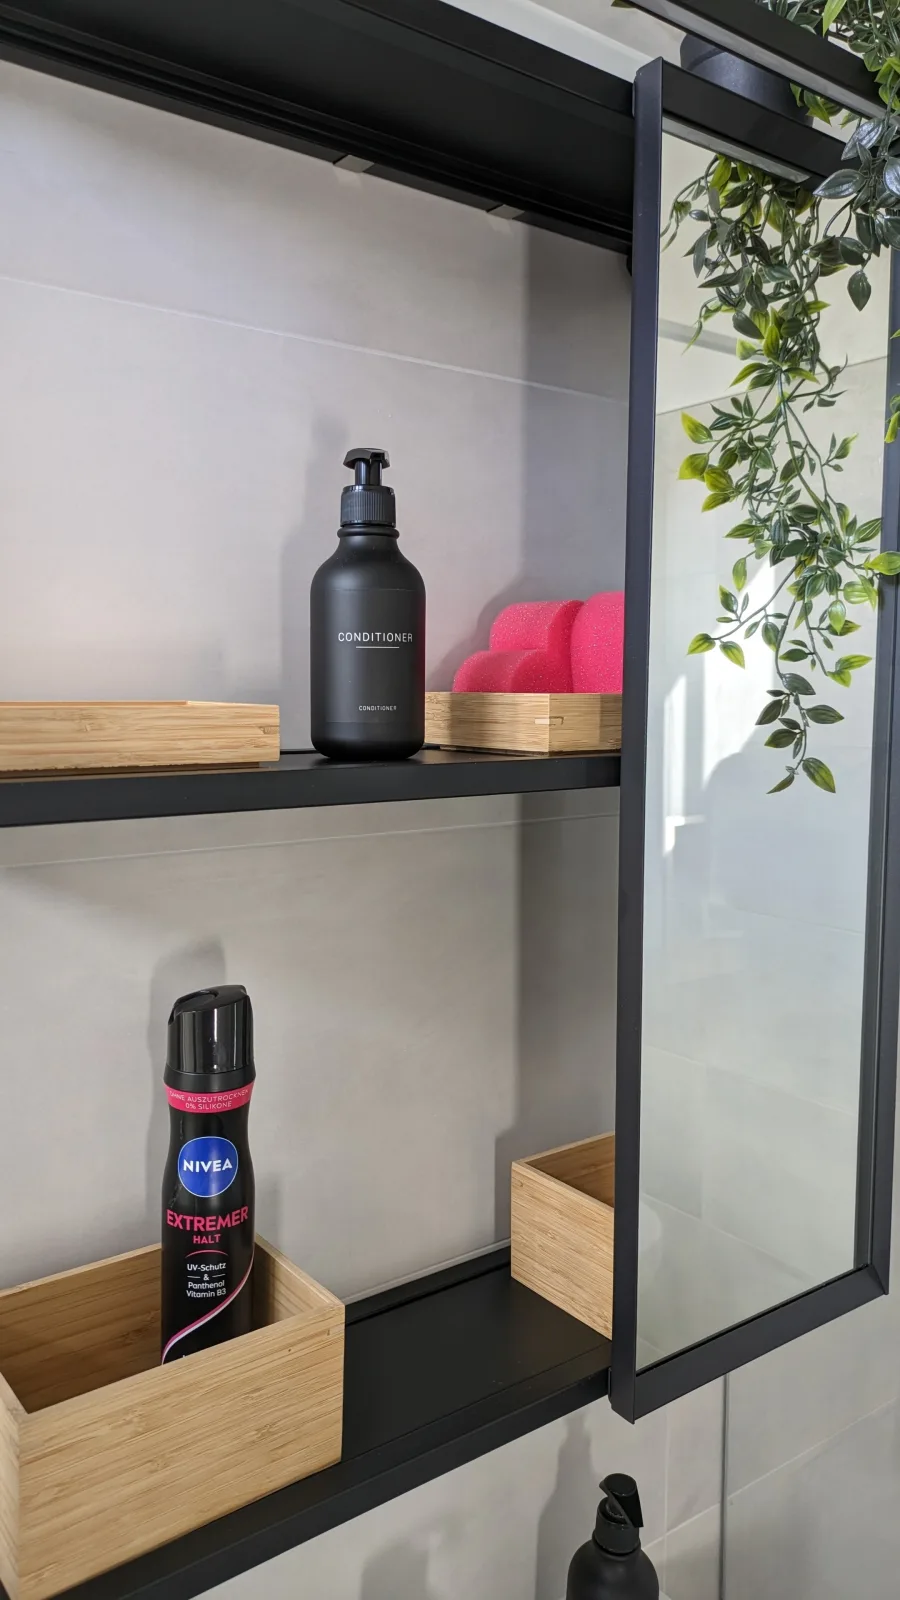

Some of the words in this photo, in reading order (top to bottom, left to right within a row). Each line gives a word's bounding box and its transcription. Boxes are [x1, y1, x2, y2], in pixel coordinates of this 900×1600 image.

[338, 632, 413, 642] CONDITIONER
[169, 1091, 185, 1101] OHNE
[185, 1102, 197, 1110] 0%
[198, 1101, 232, 1110] SILIKONE
[183, 1158, 233, 1173] NIVEA
[166, 1206, 249, 1231] EXTREMER
[193, 1234, 221, 1244] HALT
[186, 1262, 227, 1271] UV-Schutz
[203, 1273, 210, 1281] &
[188, 1280, 225, 1290] Panthenol
[186, 1289, 215, 1298] Vitamin
[216, 1288, 227, 1296] B3
